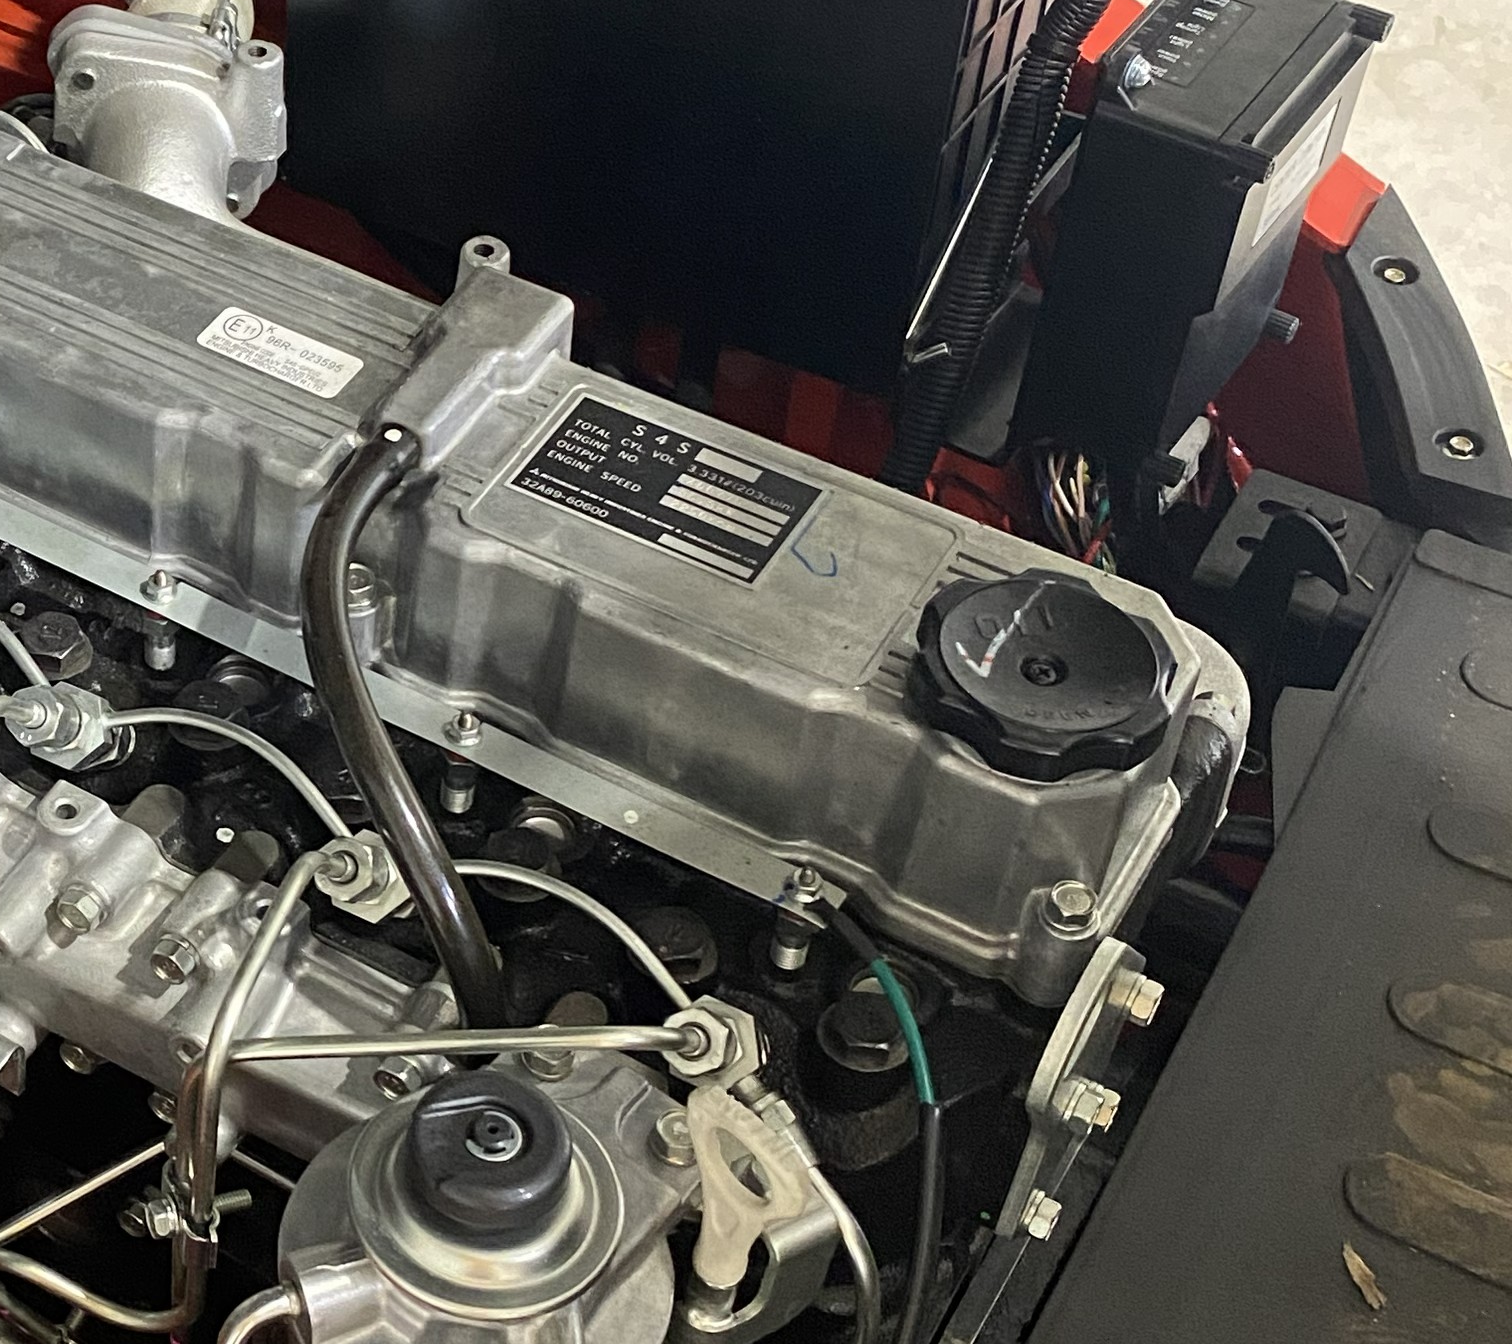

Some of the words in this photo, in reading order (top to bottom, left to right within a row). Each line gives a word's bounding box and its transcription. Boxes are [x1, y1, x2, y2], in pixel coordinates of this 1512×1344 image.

[265, 325, 278, 334] K
[571, 418, 614, 439] TOTAL
[630, 423, 649, 437] S
[652, 432, 671, 446] 4
[674, 441, 693, 454] S
[553, 438, 607, 464] OUTPUT
[563, 428, 612, 452] ENGINE
[616, 449, 642, 464] NO.
[545, 449, 594, 473] ENGINE
[598, 470, 643, 493] SPEED
